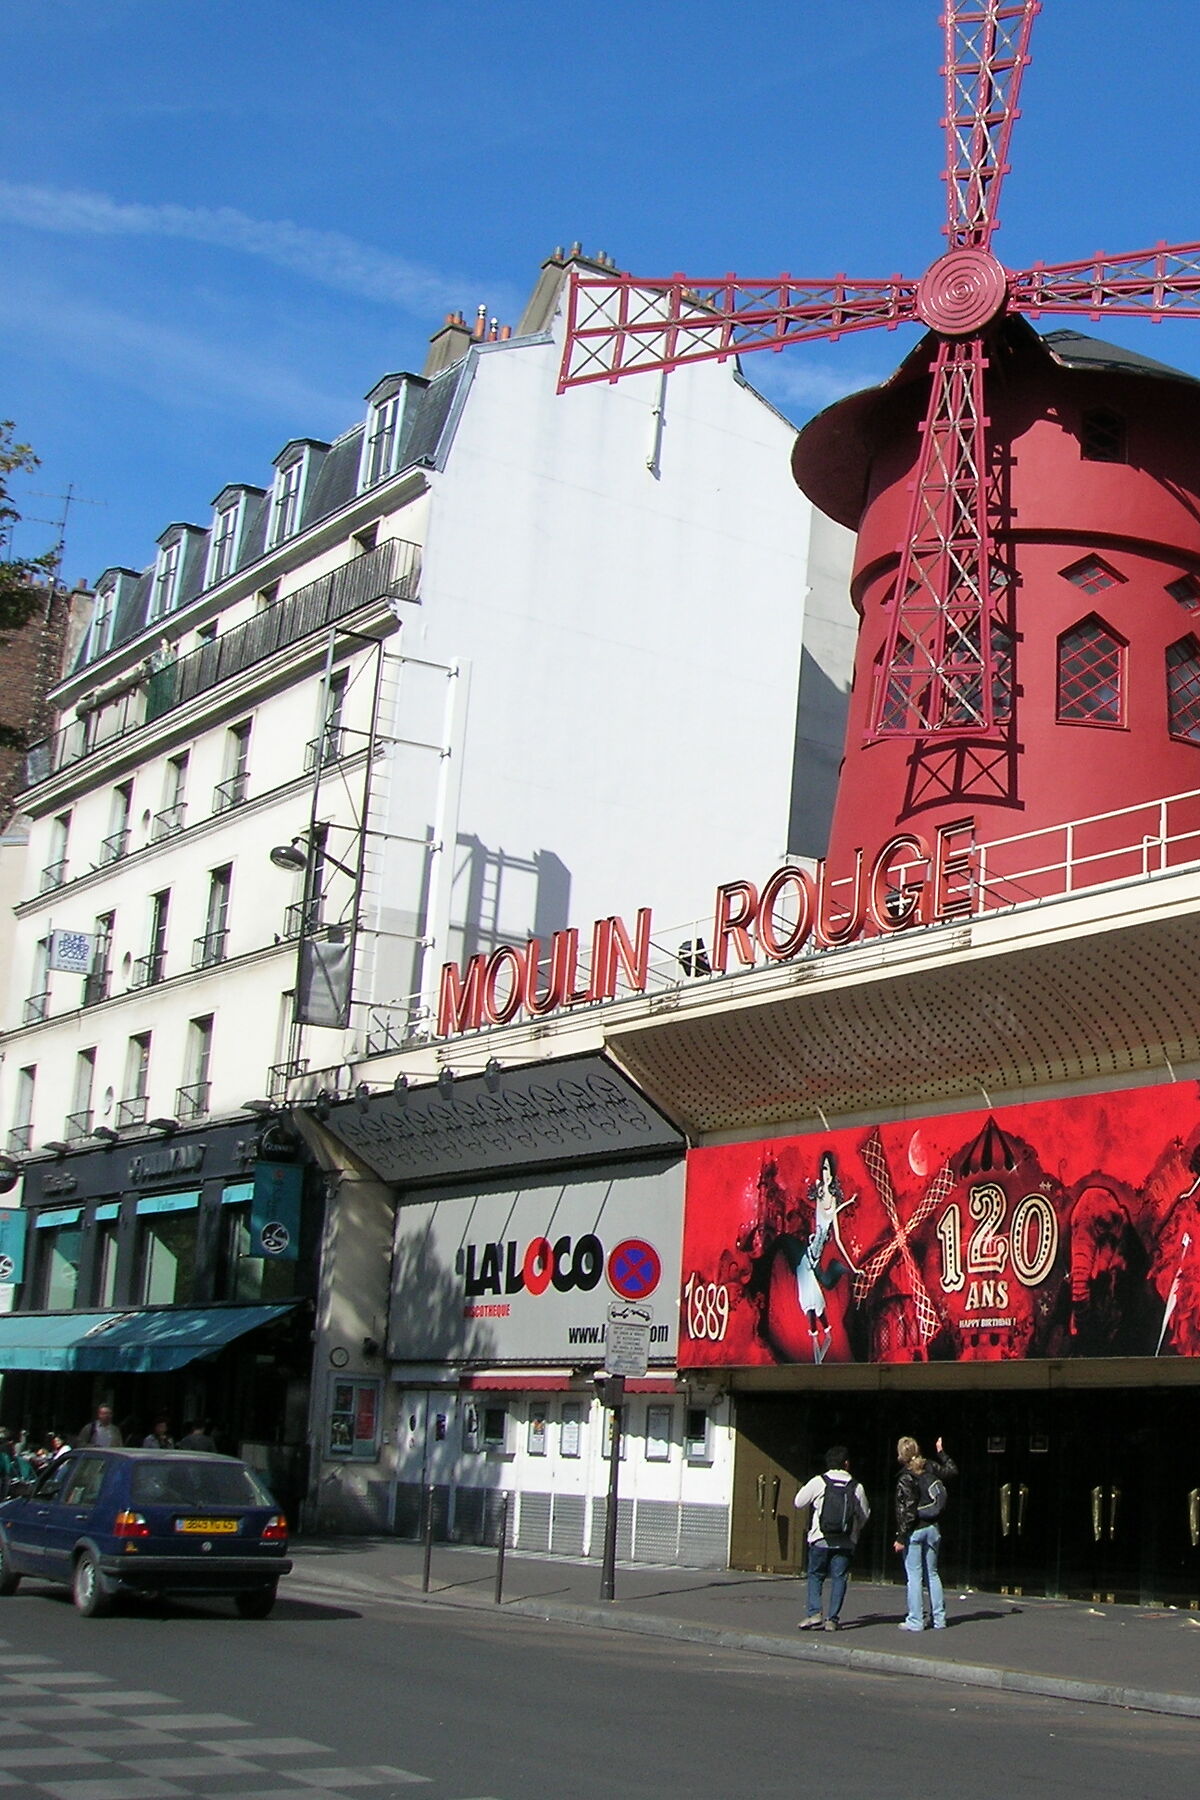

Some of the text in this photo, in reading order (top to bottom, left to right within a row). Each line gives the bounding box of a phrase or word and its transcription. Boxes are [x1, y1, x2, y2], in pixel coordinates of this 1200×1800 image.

[437, 816, 976, 1037] MOULIN ROUGE
[937, 1183, 1059, 1293] 120
[684, 1271, 729, 1341] 1889
[959, 1318, 979, 1329] HAPPY
[965, 1280, 1009, 1311] ANS
